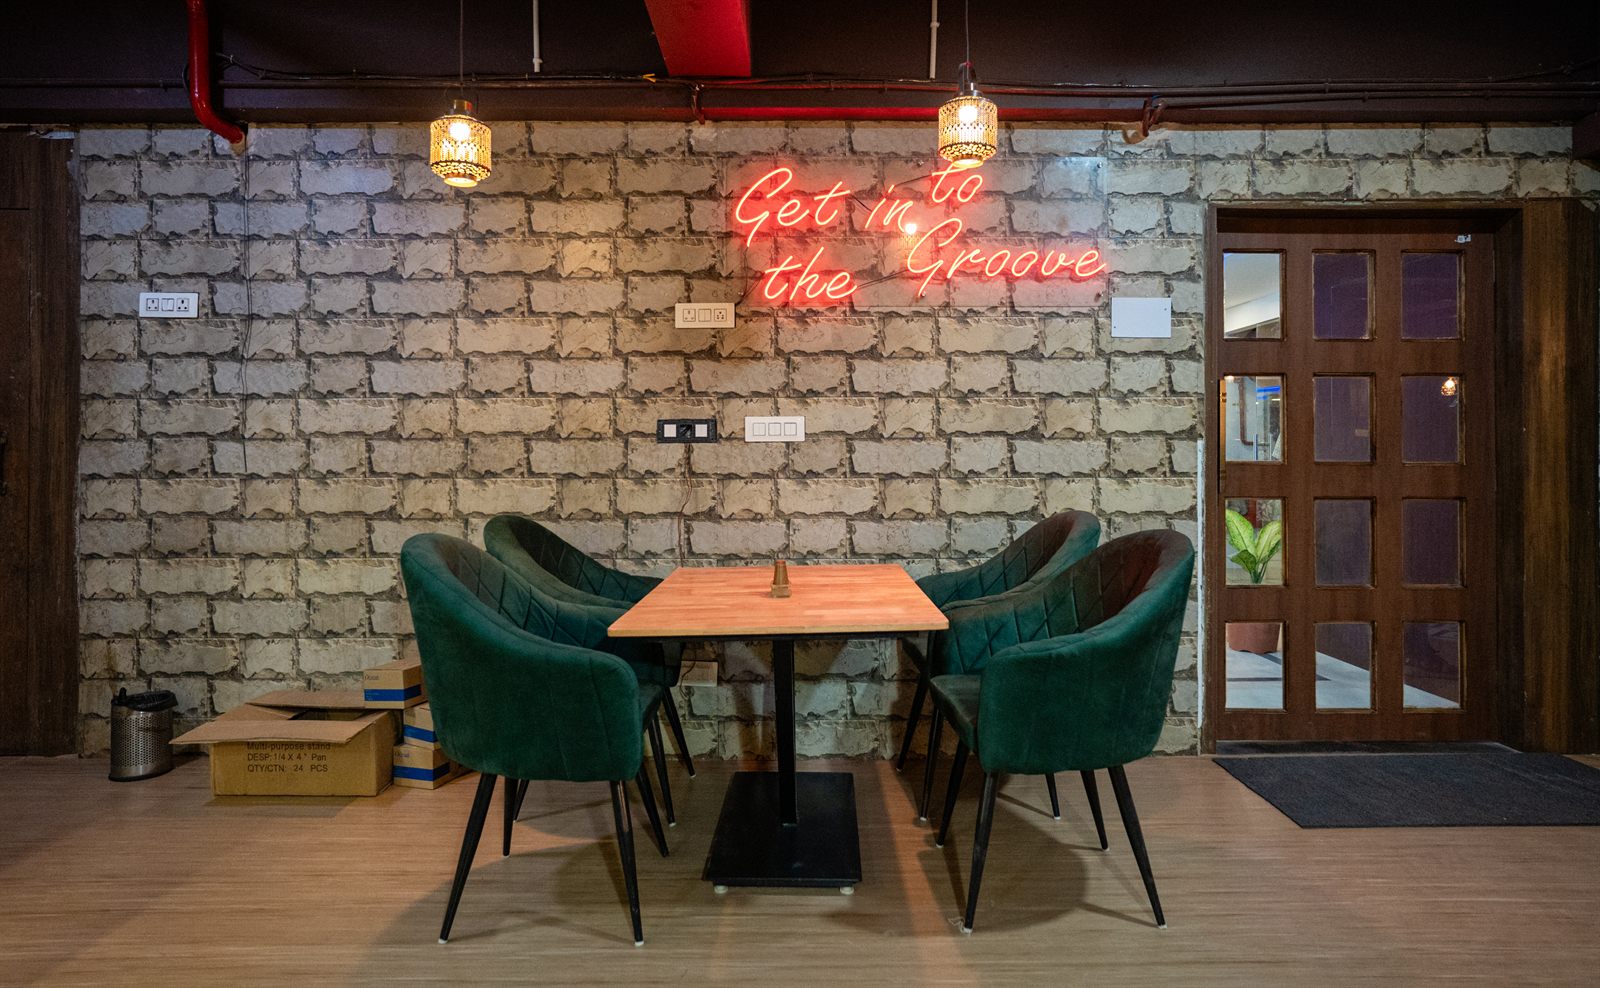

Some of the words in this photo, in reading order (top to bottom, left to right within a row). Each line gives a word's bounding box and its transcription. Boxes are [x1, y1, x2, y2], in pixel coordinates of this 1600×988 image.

[734, 167, 851, 248] Get
[864, 184, 914, 231] in
[930, 163, 984, 204] to
[762, 247, 858, 301] the
[906, 217, 1108, 297] Groove
[308, 742, 331, 751] stand
[311, 753, 327, 761] Pan
[293, 764, 304, 773] 24
[310, 764, 329, 773] PCS
